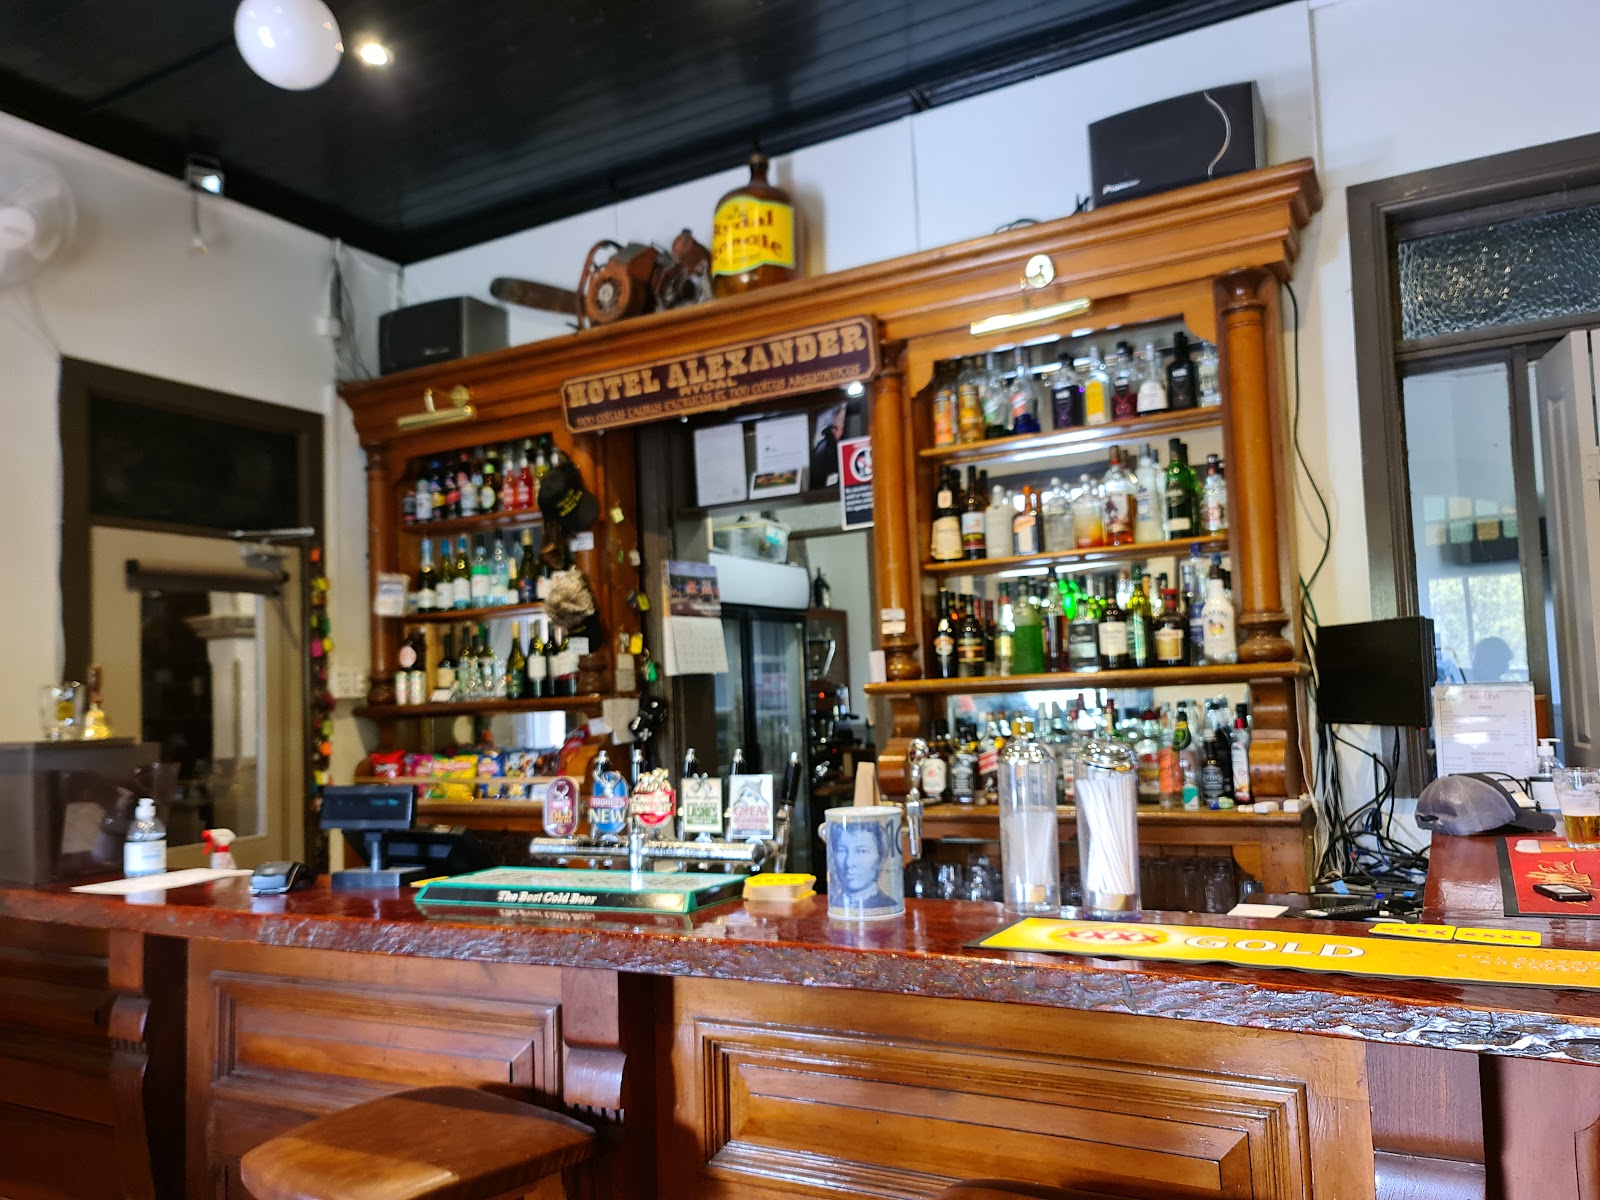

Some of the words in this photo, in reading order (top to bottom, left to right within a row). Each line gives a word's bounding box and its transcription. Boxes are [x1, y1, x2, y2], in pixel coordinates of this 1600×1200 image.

[567, 367, 661, 409] HOTEL
[667, 324, 867, 389] ALEXANDER
[678, 377, 738, 396] RYDAL
[589, 808, 626, 823] NEW
[497, 890, 518, 902] The
[518, 891, 542, 904] Best
[542, 891, 571, 905] Cold
[569, 893, 597, 905] Beer
[1056, 929, 1162, 944] XXXX
[1184, 935, 1366, 958] GOLD
